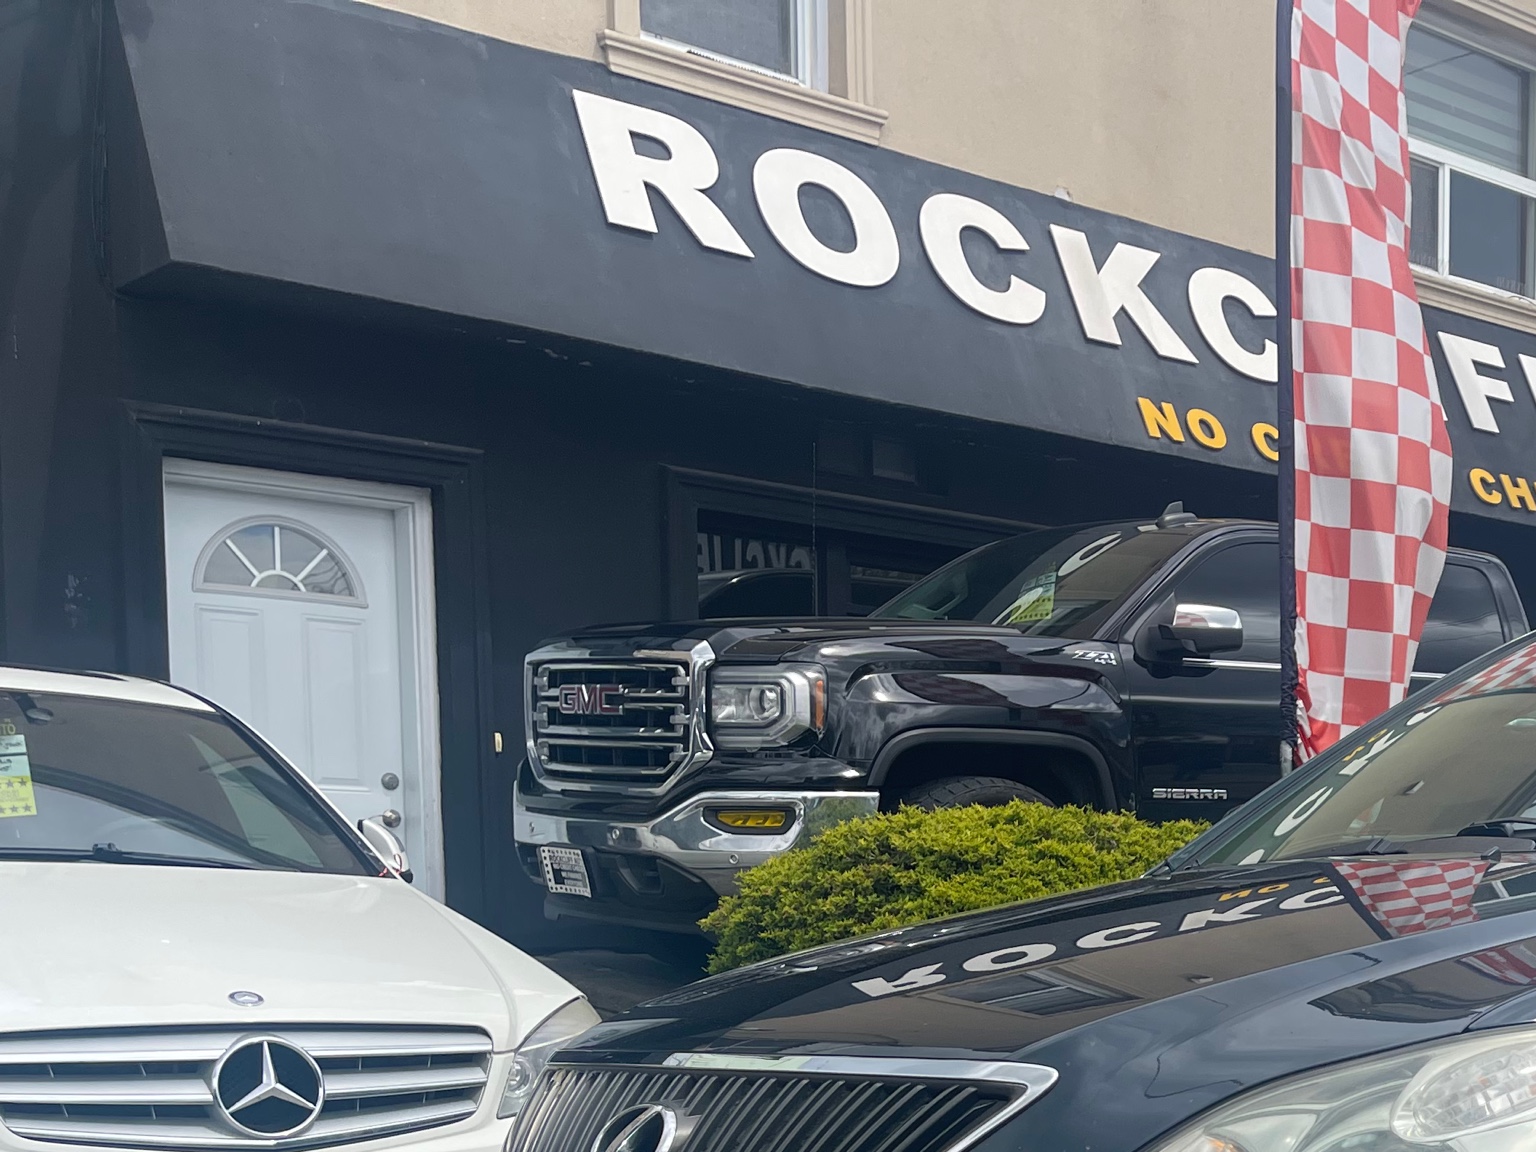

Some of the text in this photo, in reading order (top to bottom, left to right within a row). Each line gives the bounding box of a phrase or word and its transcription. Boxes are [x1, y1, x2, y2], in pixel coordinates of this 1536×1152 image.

[1137, 396, 1229, 450] NO
[559, 684, 624, 714] GMC
[1152, 788, 1228, 800] SIERRA
